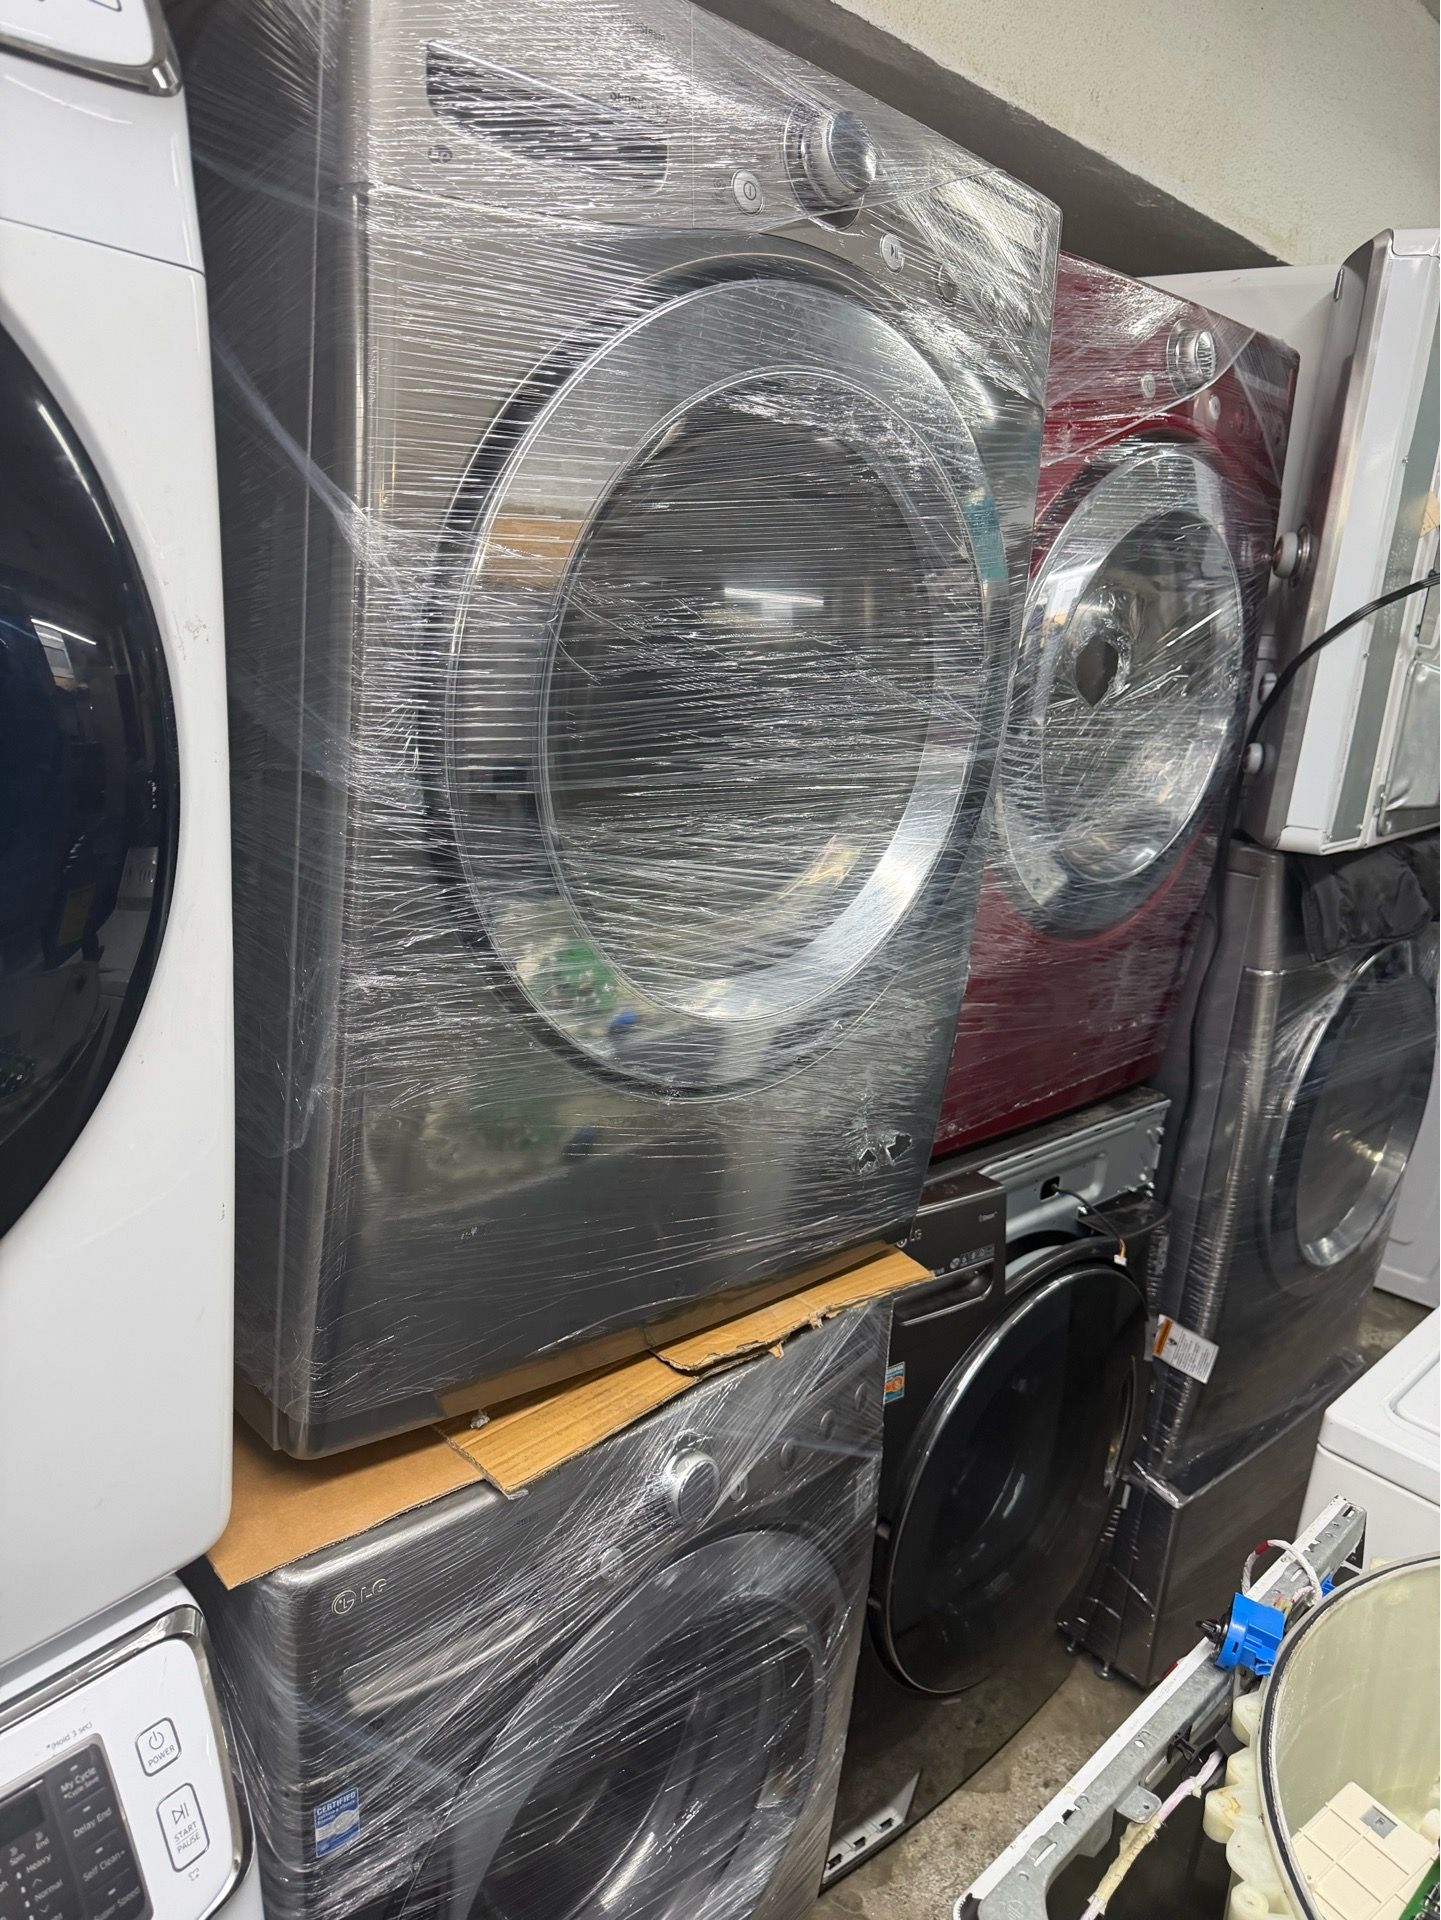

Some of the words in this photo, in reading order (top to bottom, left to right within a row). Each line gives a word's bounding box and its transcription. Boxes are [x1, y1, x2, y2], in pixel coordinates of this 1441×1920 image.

[147, 1744, 176, 1767] POWER
[60, 1781, 74, 1792] My
[75, 1767, 97, 1784] Cycle
[316, 1791, 356, 1816] CERTIFIED
[73, 1820, 95, 1838] Delay
[96, 1807, 112, 1824] End
[174, 1821, 198, 1842] START
[176, 1832, 201, 1853] PAUSE
